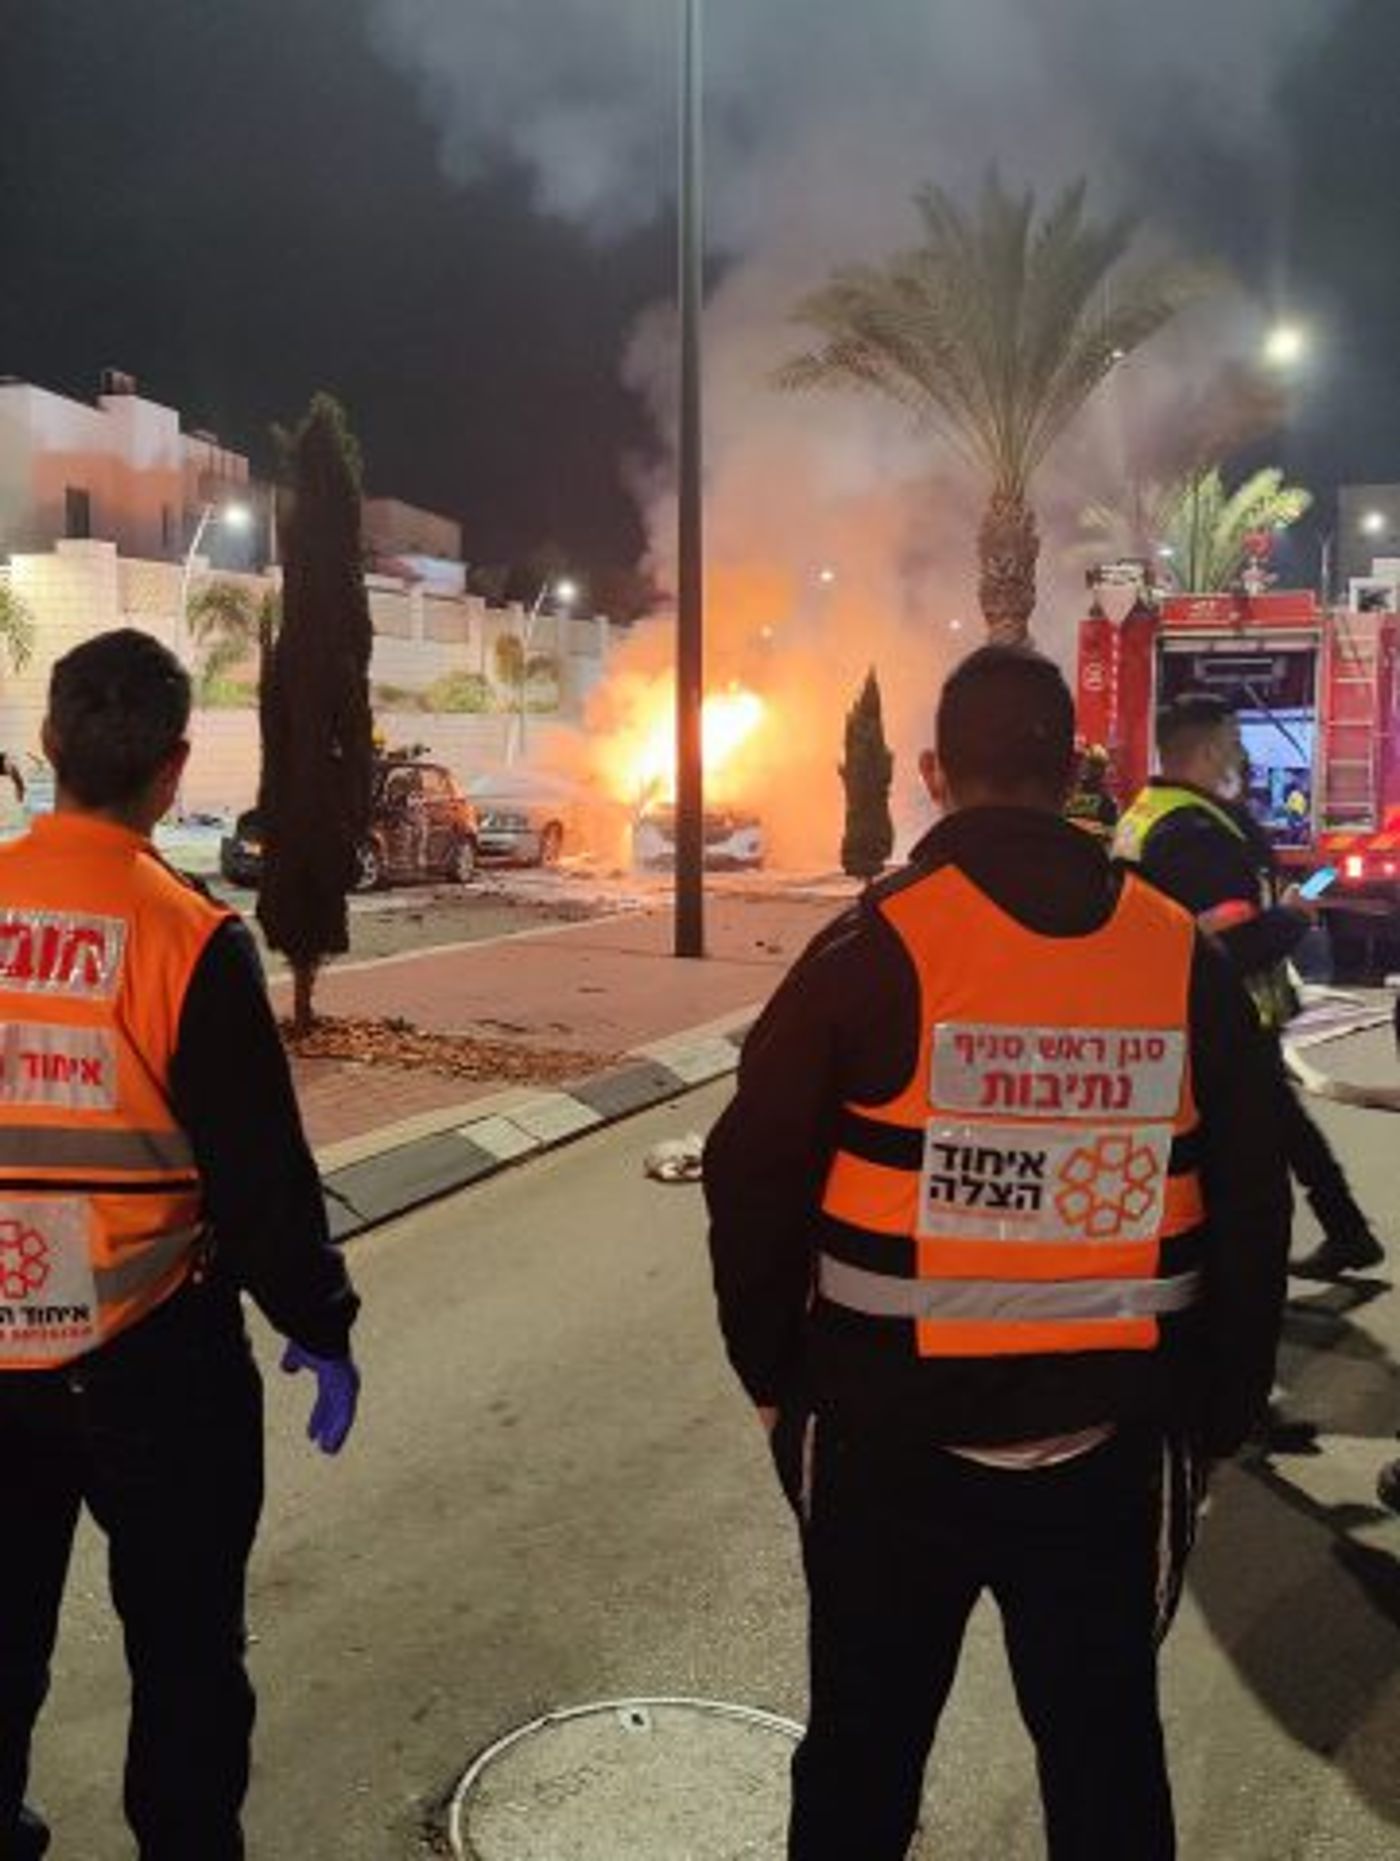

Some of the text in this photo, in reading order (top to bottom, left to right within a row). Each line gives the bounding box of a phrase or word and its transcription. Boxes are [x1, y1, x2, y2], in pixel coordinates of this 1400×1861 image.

[954, 1033, 1024, 1064] סניף
[1039, 1034, 1106, 1061] ראש
[20, 1053, 102, 1087] איחוד
[981, 1070, 1133, 1109] נתיבות
[931, 1143, 1048, 1179] איחוד
[929, 1174, 1041, 1211] הצלה
[20, 1304, 90, 1328] איחוד
